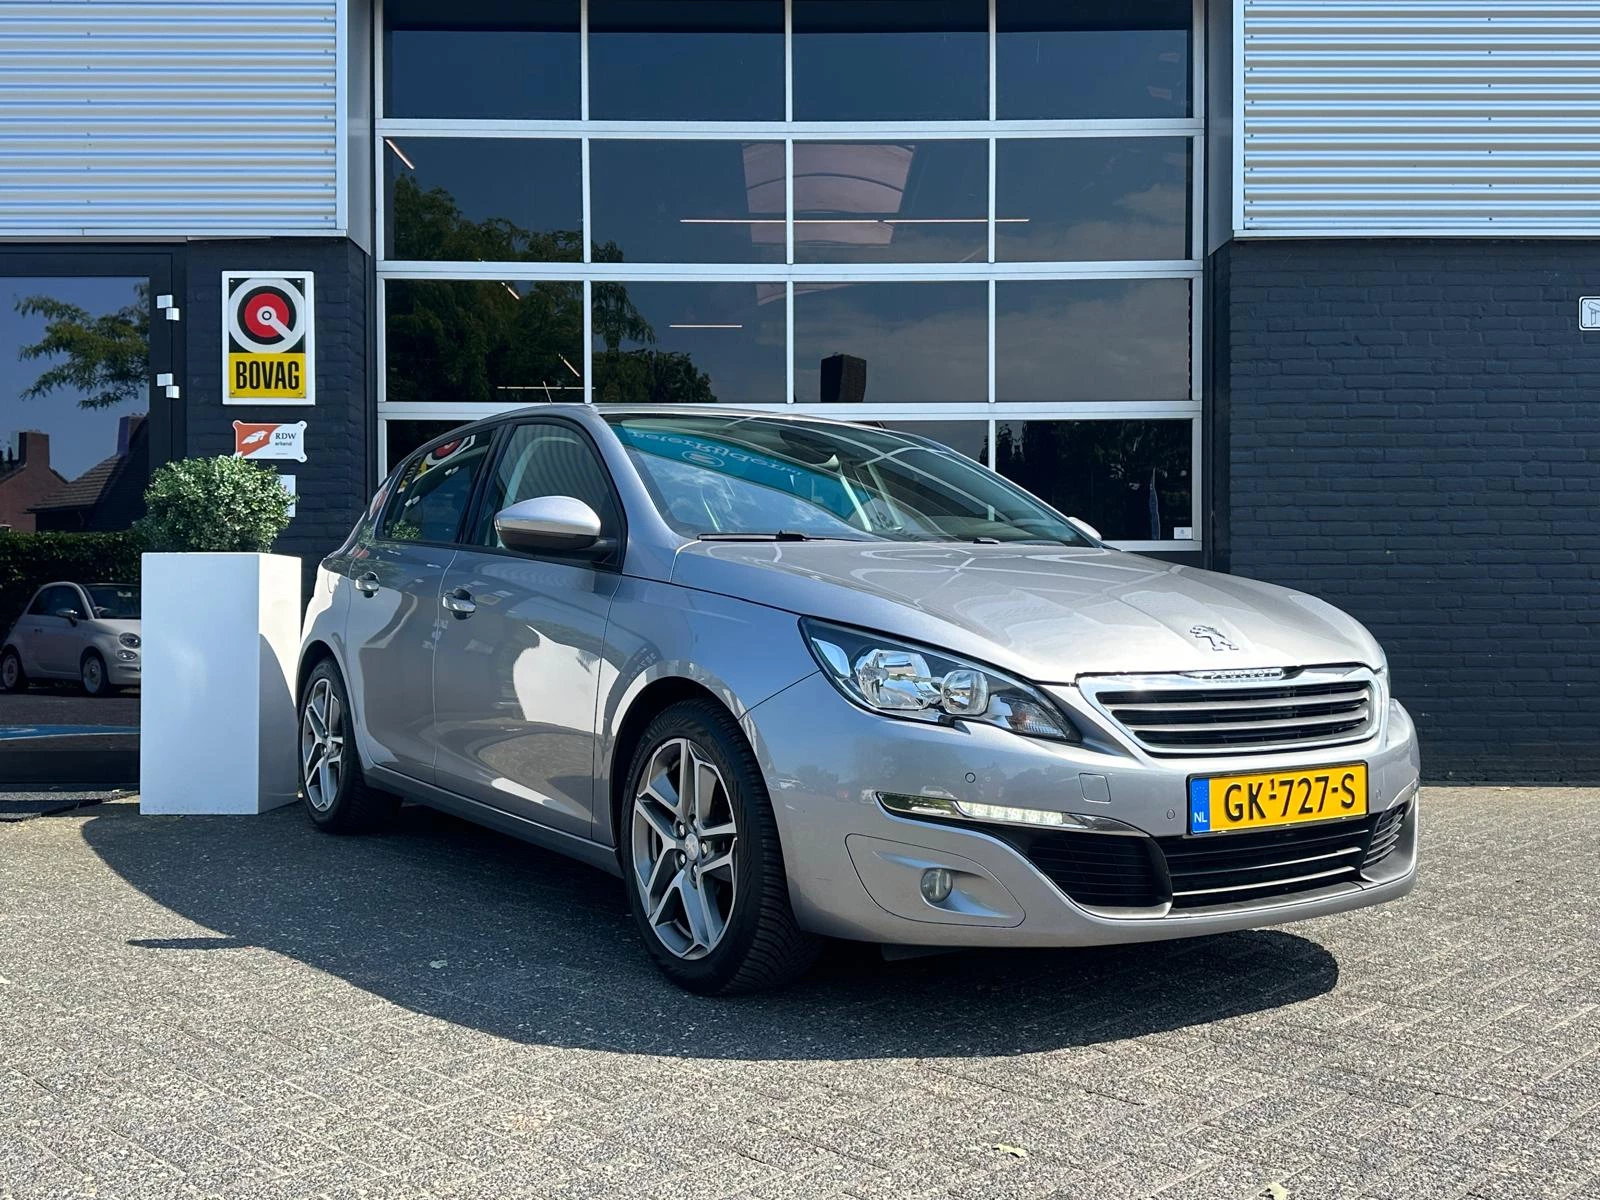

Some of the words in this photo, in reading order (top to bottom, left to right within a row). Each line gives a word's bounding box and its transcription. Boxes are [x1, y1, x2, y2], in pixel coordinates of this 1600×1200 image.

[235, 360, 300, 390] BOVAG
[275, 432, 297, 440] RDW
[1193, 811, 1208, 823] NL
